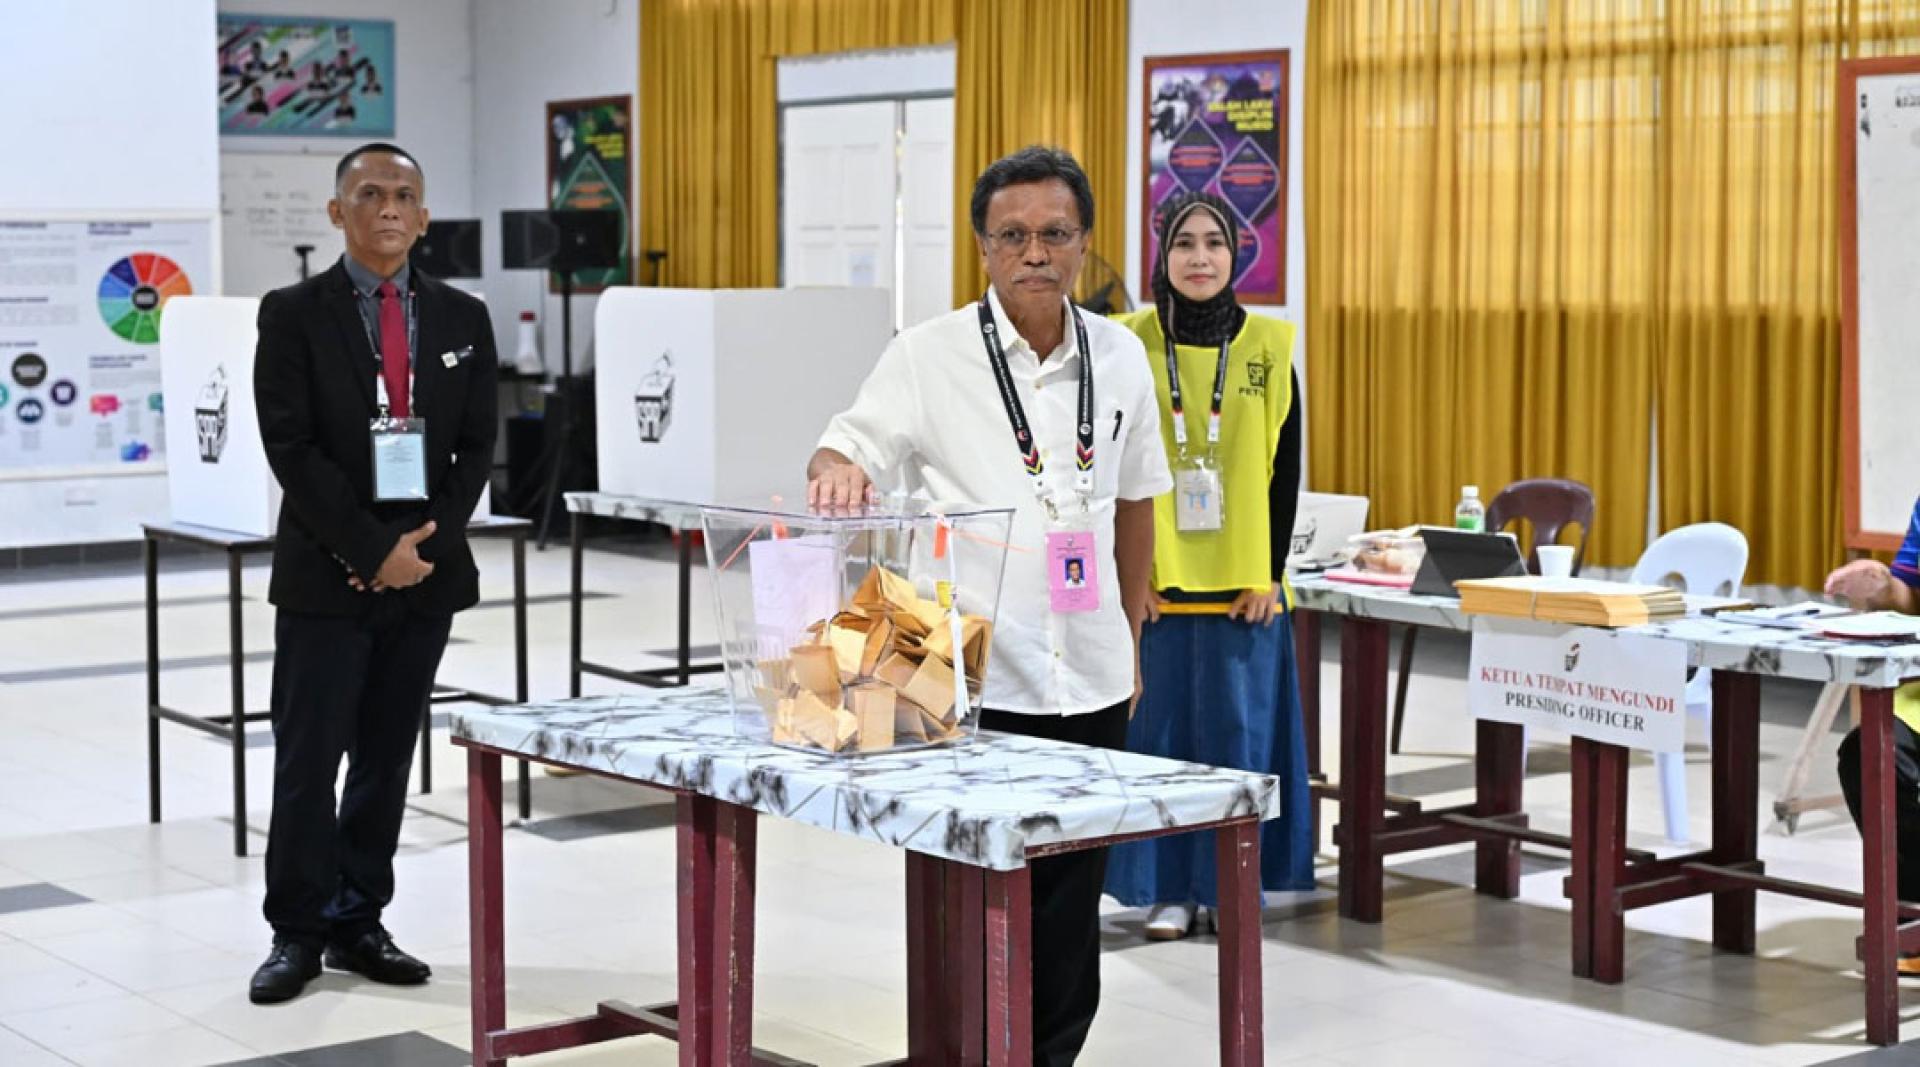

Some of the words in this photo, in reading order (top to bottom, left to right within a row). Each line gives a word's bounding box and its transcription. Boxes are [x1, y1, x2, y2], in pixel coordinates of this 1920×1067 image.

[1481, 666, 1533, 688] KETUA
[1536, 674, 1585, 697] TEMPAT
[1587, 683, 1675, 714] MENGUNDI
[1505, 691, 1575, 719] PRESIDING
[1578, 705, 1644, 732] OFFICER
